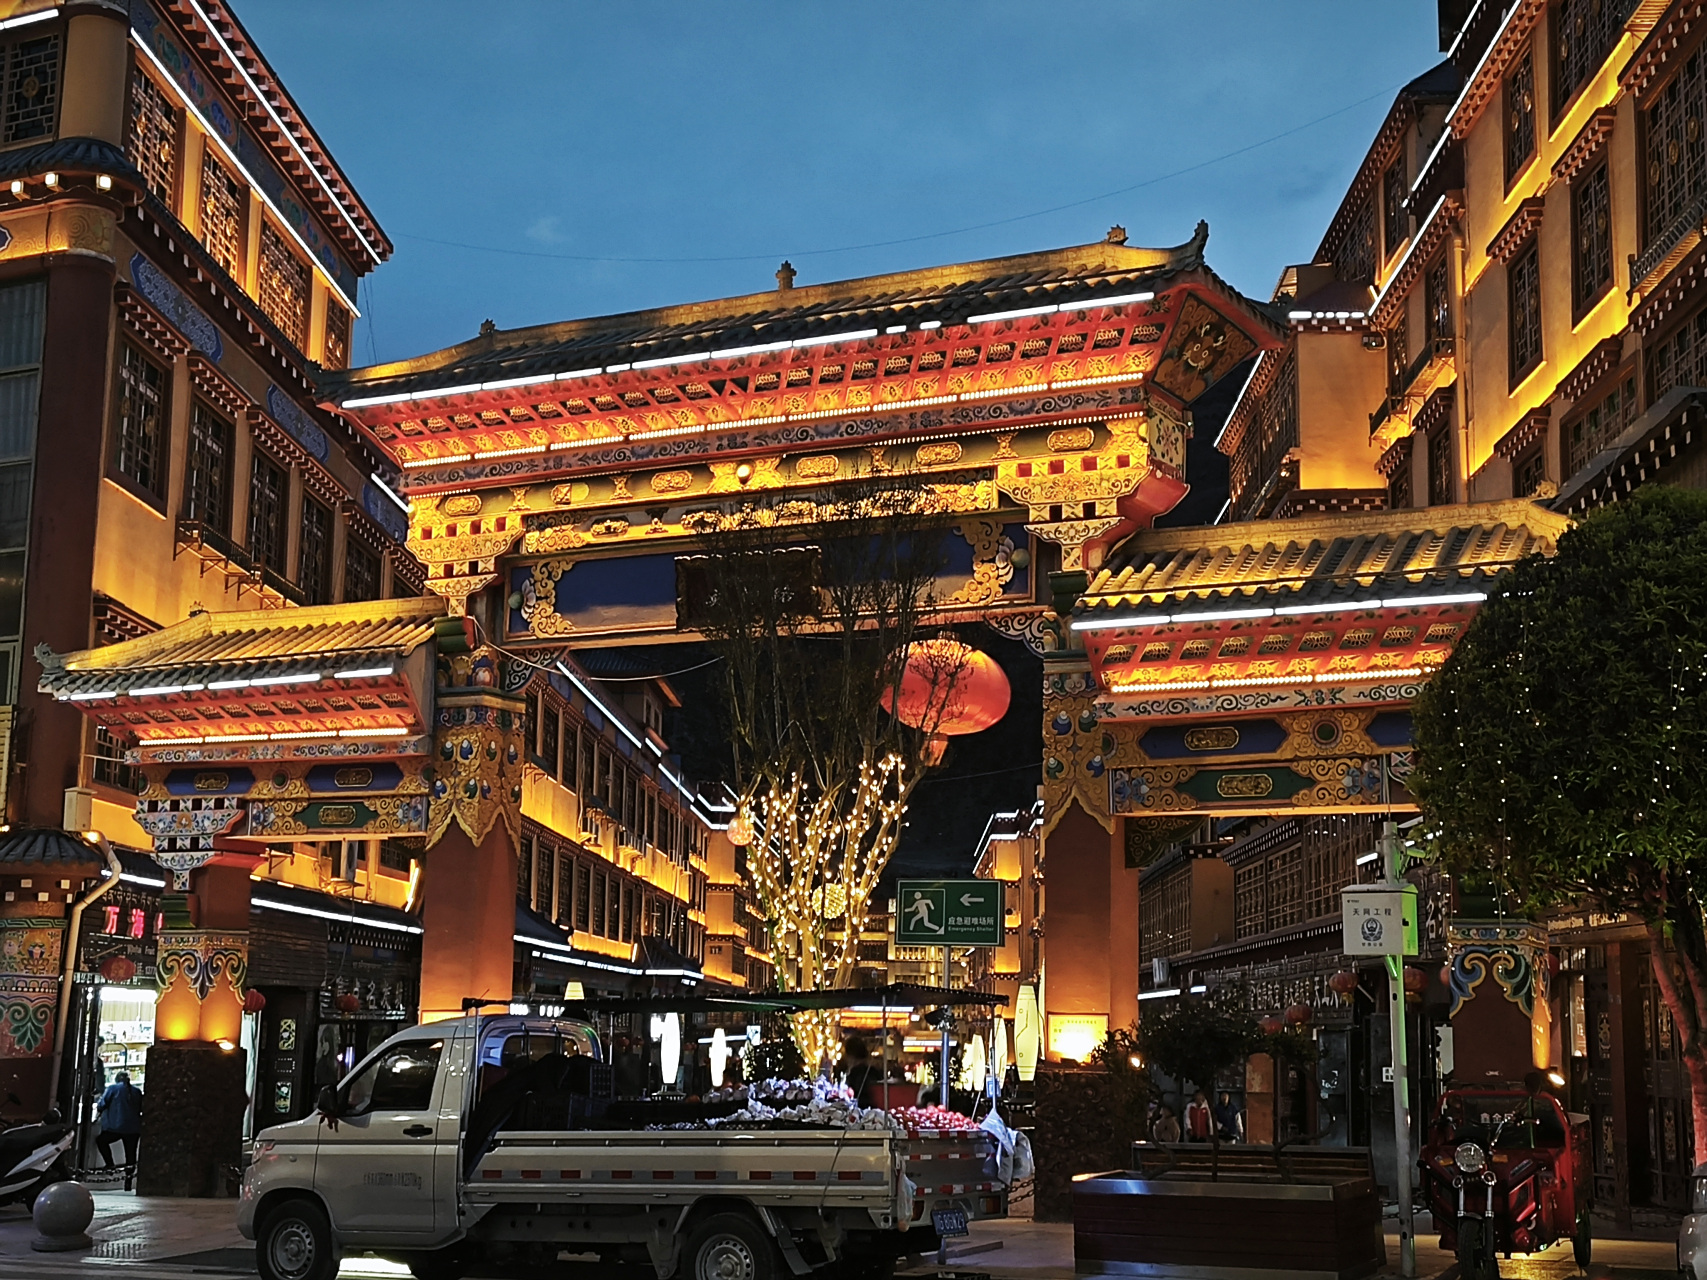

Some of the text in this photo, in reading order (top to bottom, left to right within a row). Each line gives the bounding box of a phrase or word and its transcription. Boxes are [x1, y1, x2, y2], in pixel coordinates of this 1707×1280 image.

[948, 916, 994, 925] 应急避难场所
